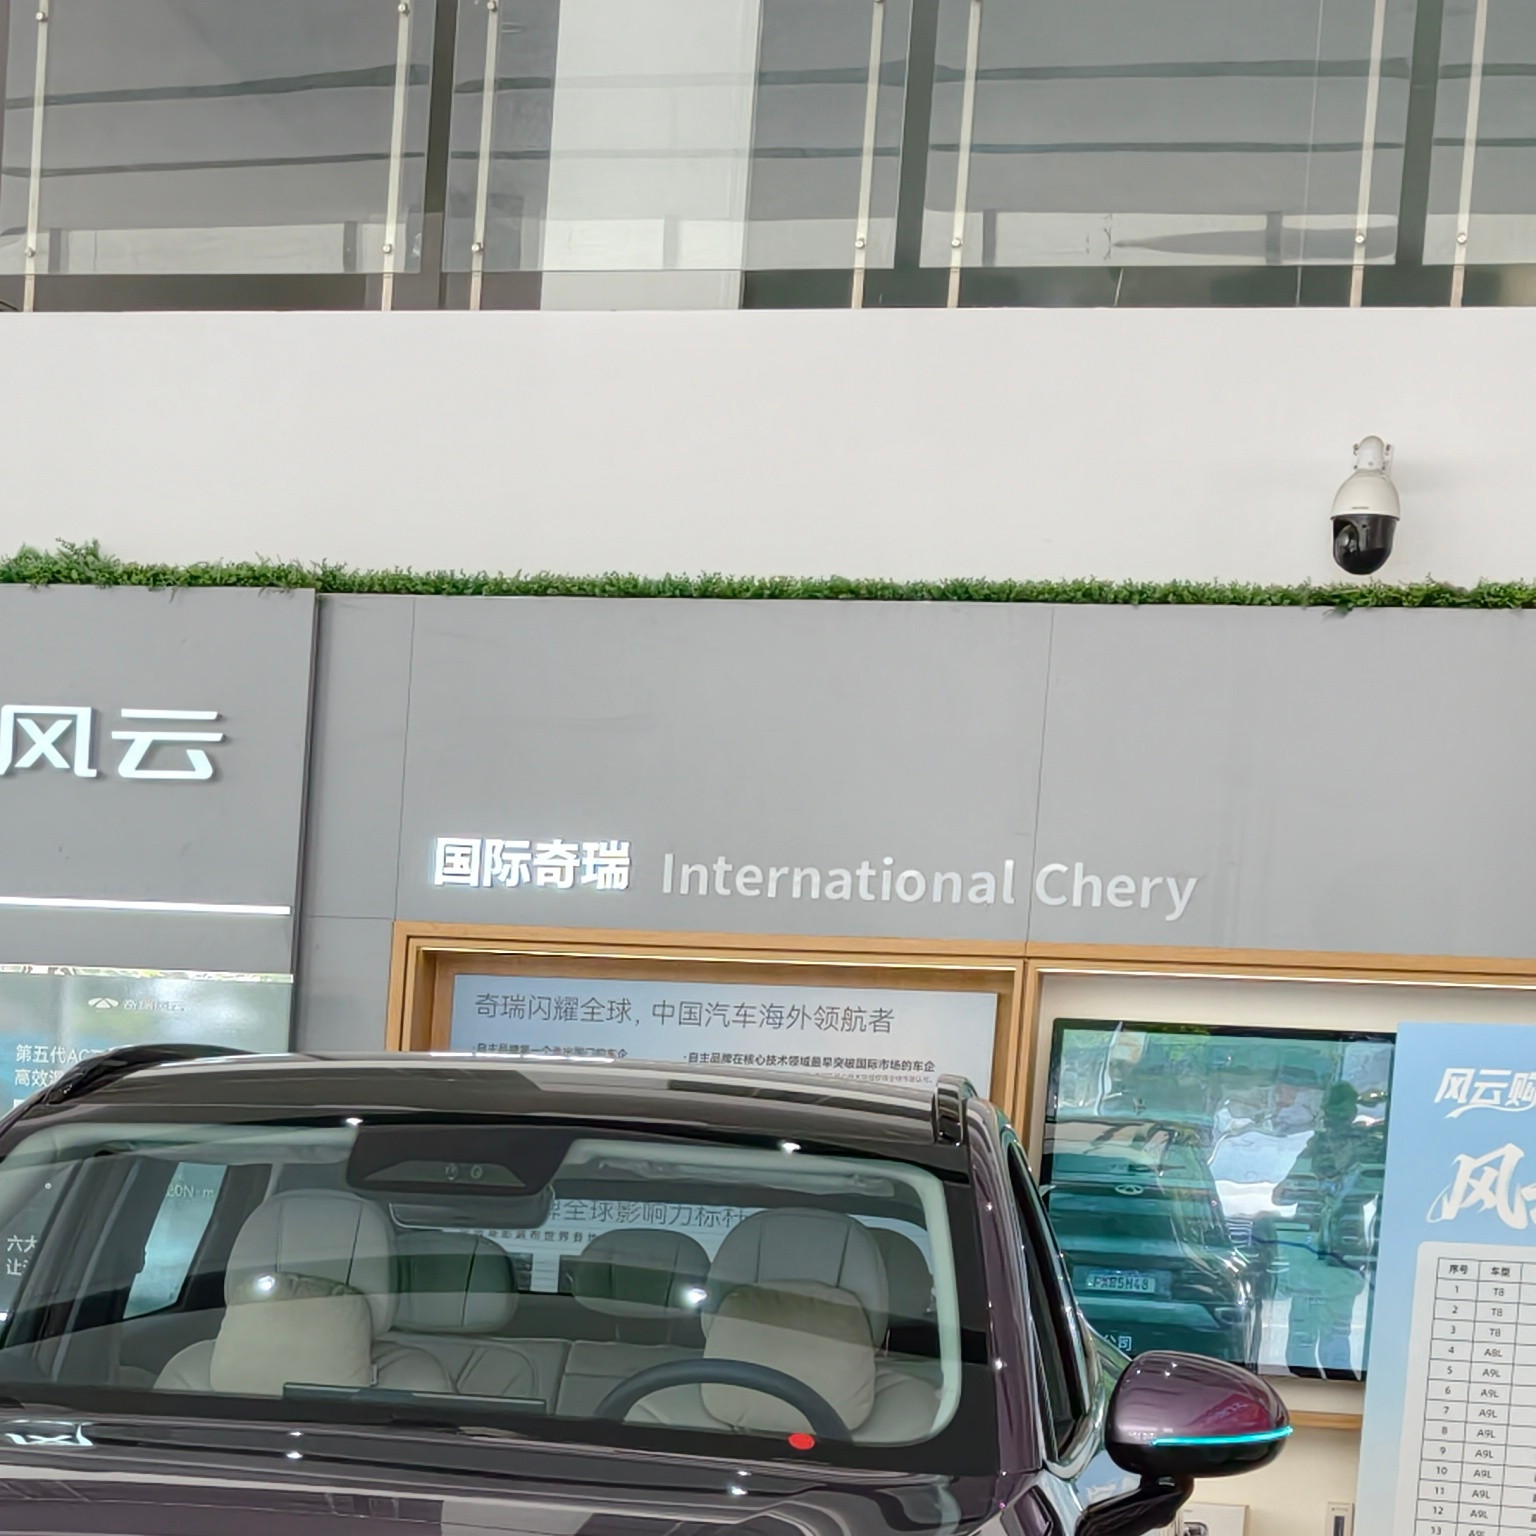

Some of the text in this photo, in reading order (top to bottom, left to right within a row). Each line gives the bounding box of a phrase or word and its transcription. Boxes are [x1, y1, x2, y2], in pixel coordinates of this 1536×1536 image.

[432, 836, 632, 892] 国际奇瑞
[662, 852, 1199, 922] International Chery
[1426, 1142, 1536, 1230] 风
